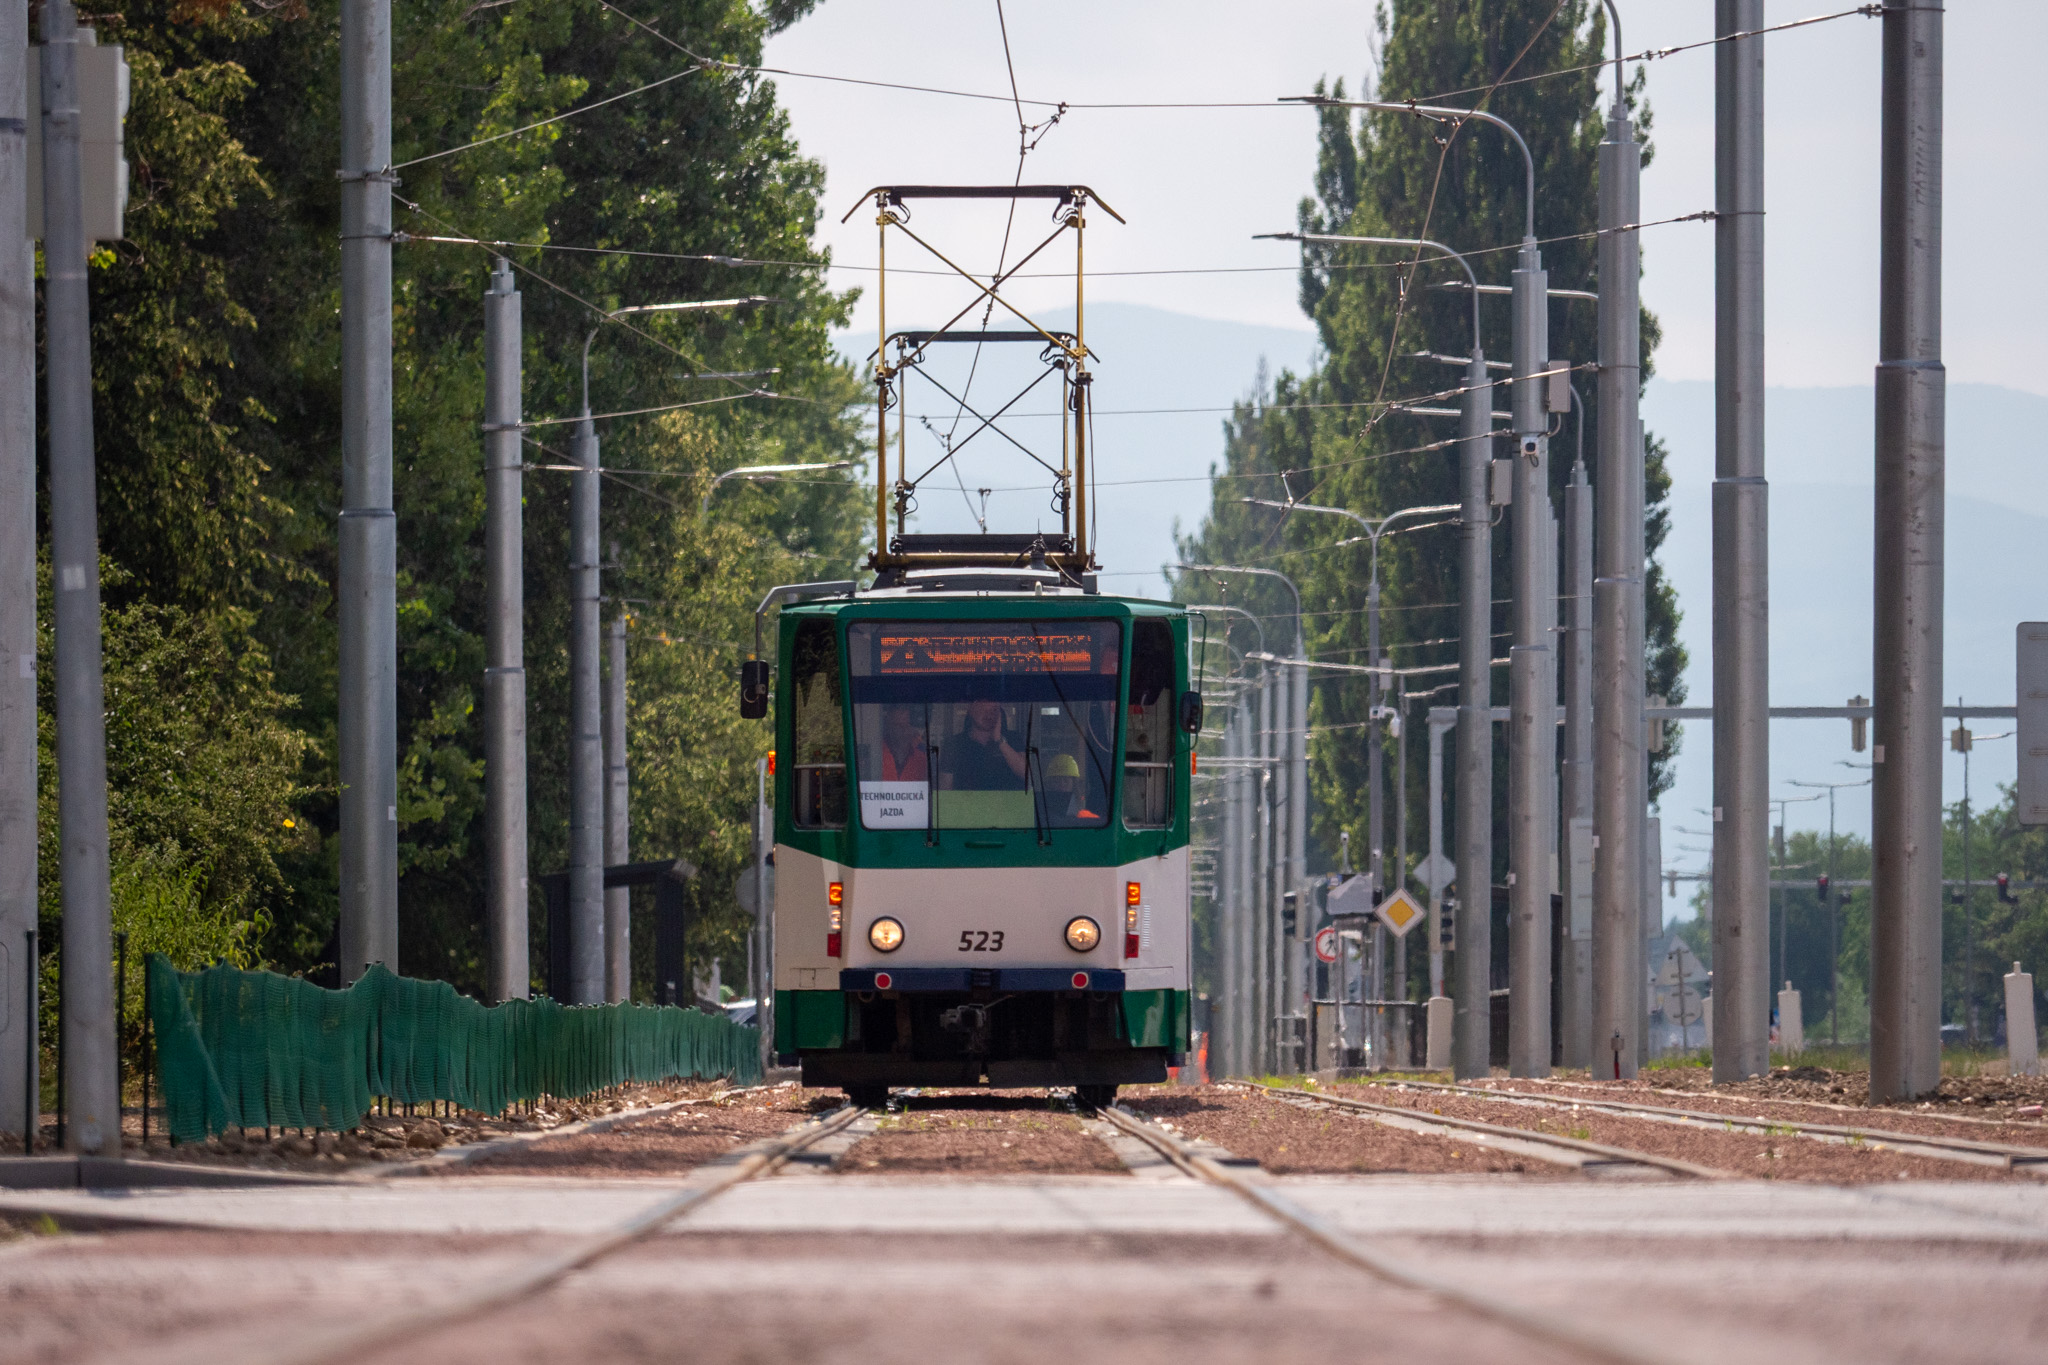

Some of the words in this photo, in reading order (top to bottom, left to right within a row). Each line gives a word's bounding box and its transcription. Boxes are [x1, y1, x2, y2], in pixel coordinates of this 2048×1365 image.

[860, 791, 924, 801] TECHNOLOGICKÁ
[880, 808, 904, 818] JAZDA
[958, 930, 1004, 952] 523
